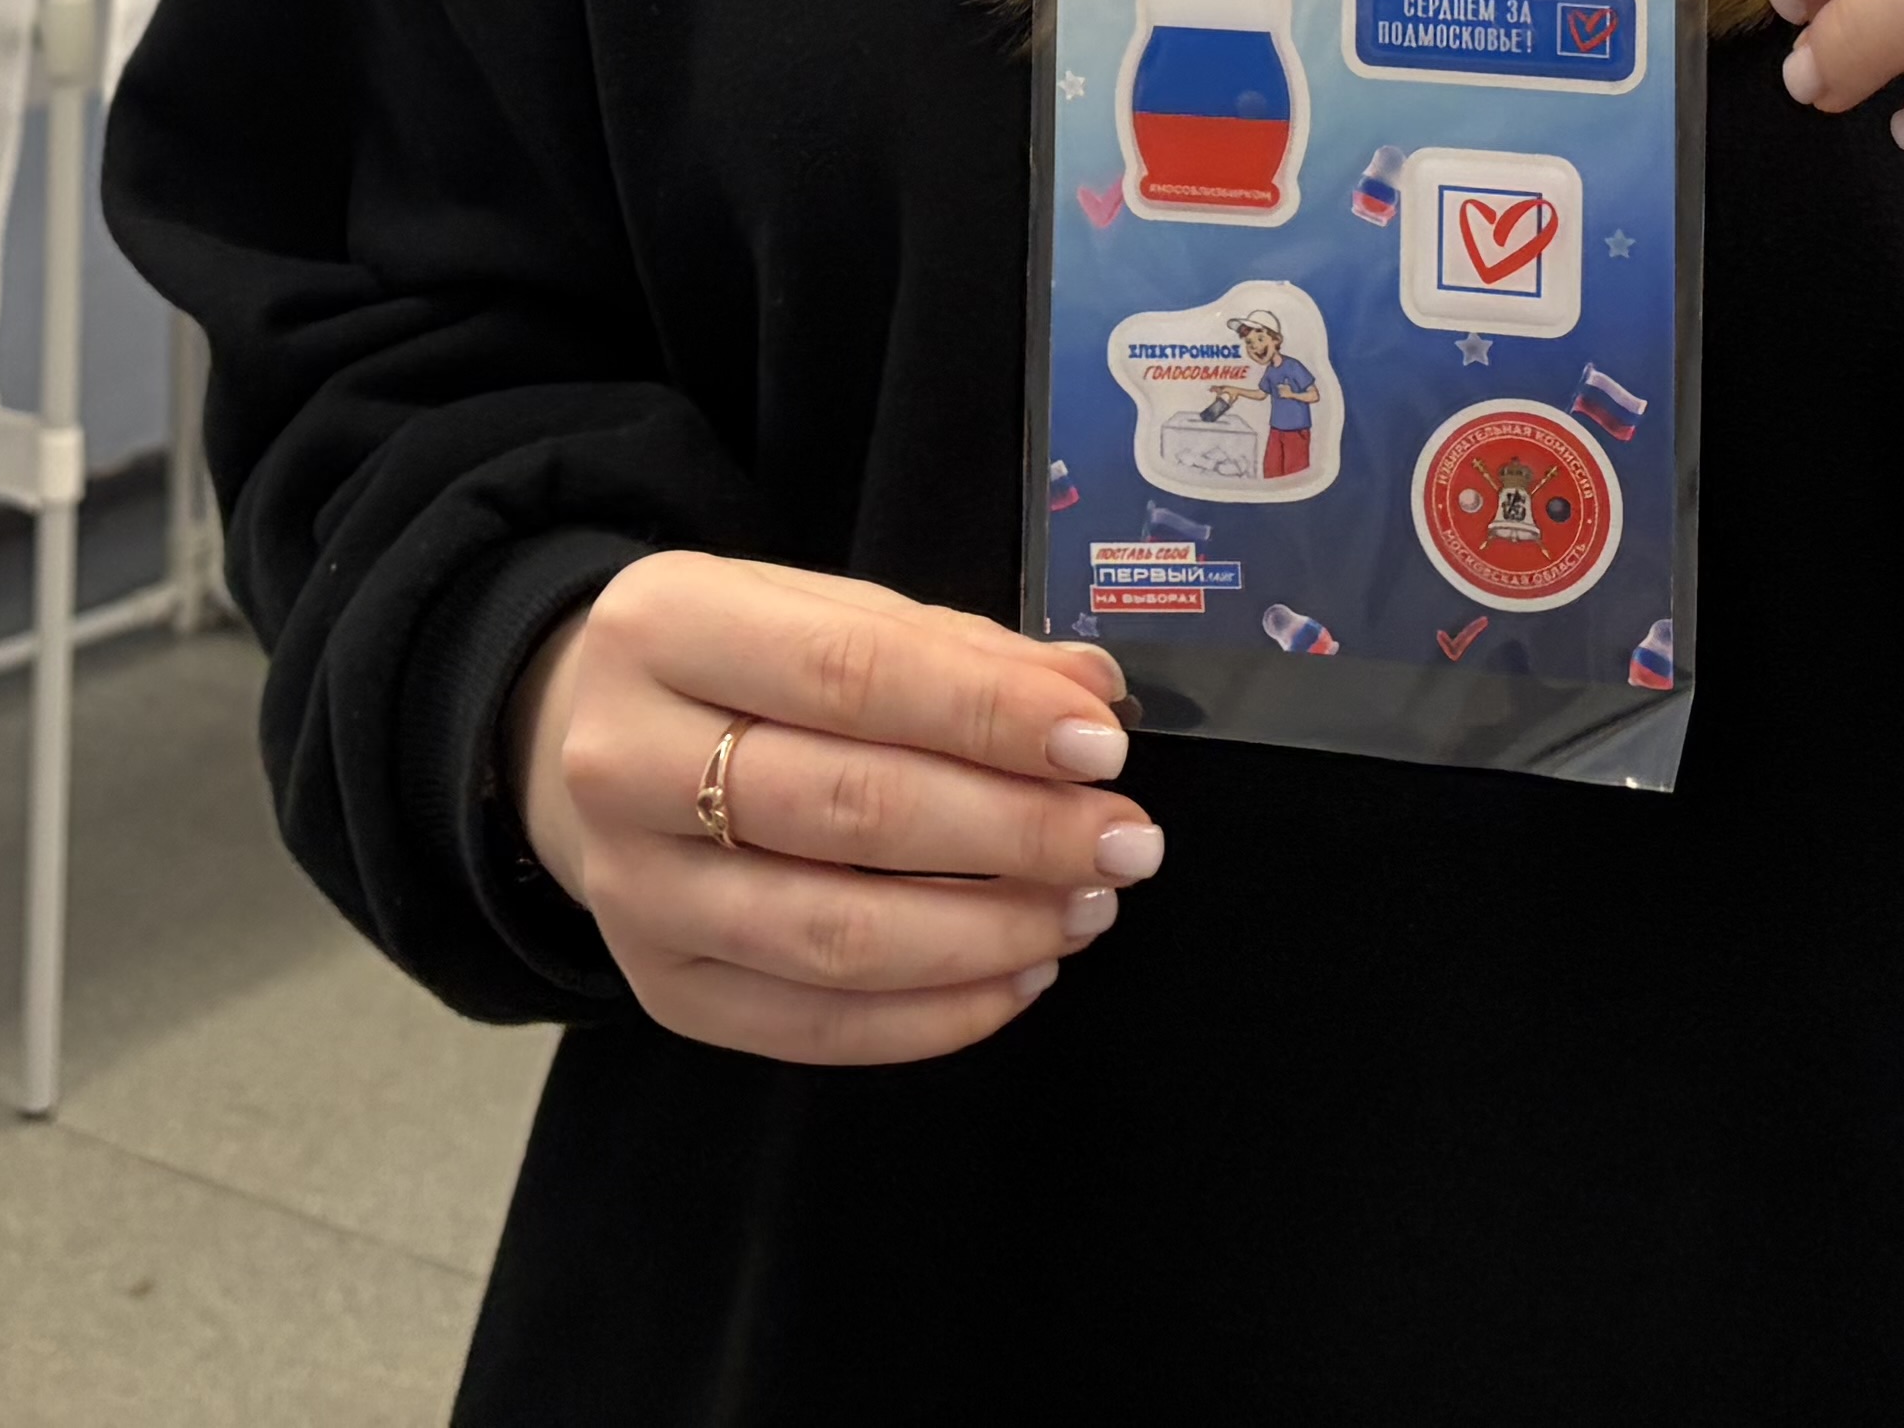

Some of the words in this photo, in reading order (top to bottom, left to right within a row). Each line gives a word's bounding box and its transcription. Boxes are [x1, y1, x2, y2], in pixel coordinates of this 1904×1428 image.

[1506, 0, 1532, 24] ЗА
[1378, 21, 1532, 53] ПОДМОСКОВЬЕ!
[1143, 365, 1250, 380] ГОЛОСОВАНИЕ
[1535, 428, 1594, 499] КОМИССИЯ
[1096, 547, 1153, 561] ПОСТАВЬ
[1442, 529, 1530, 585] МОСКОВСКАЯ
[1534, 543, 1586, 585] ОБЛАСТЬ
[1099, 566, 1205, 583] ПЕРВЫЙ
[1096, 594, 1117, 603] НА
[1122, 593, 1198, 604] ВЫБОРАХ
